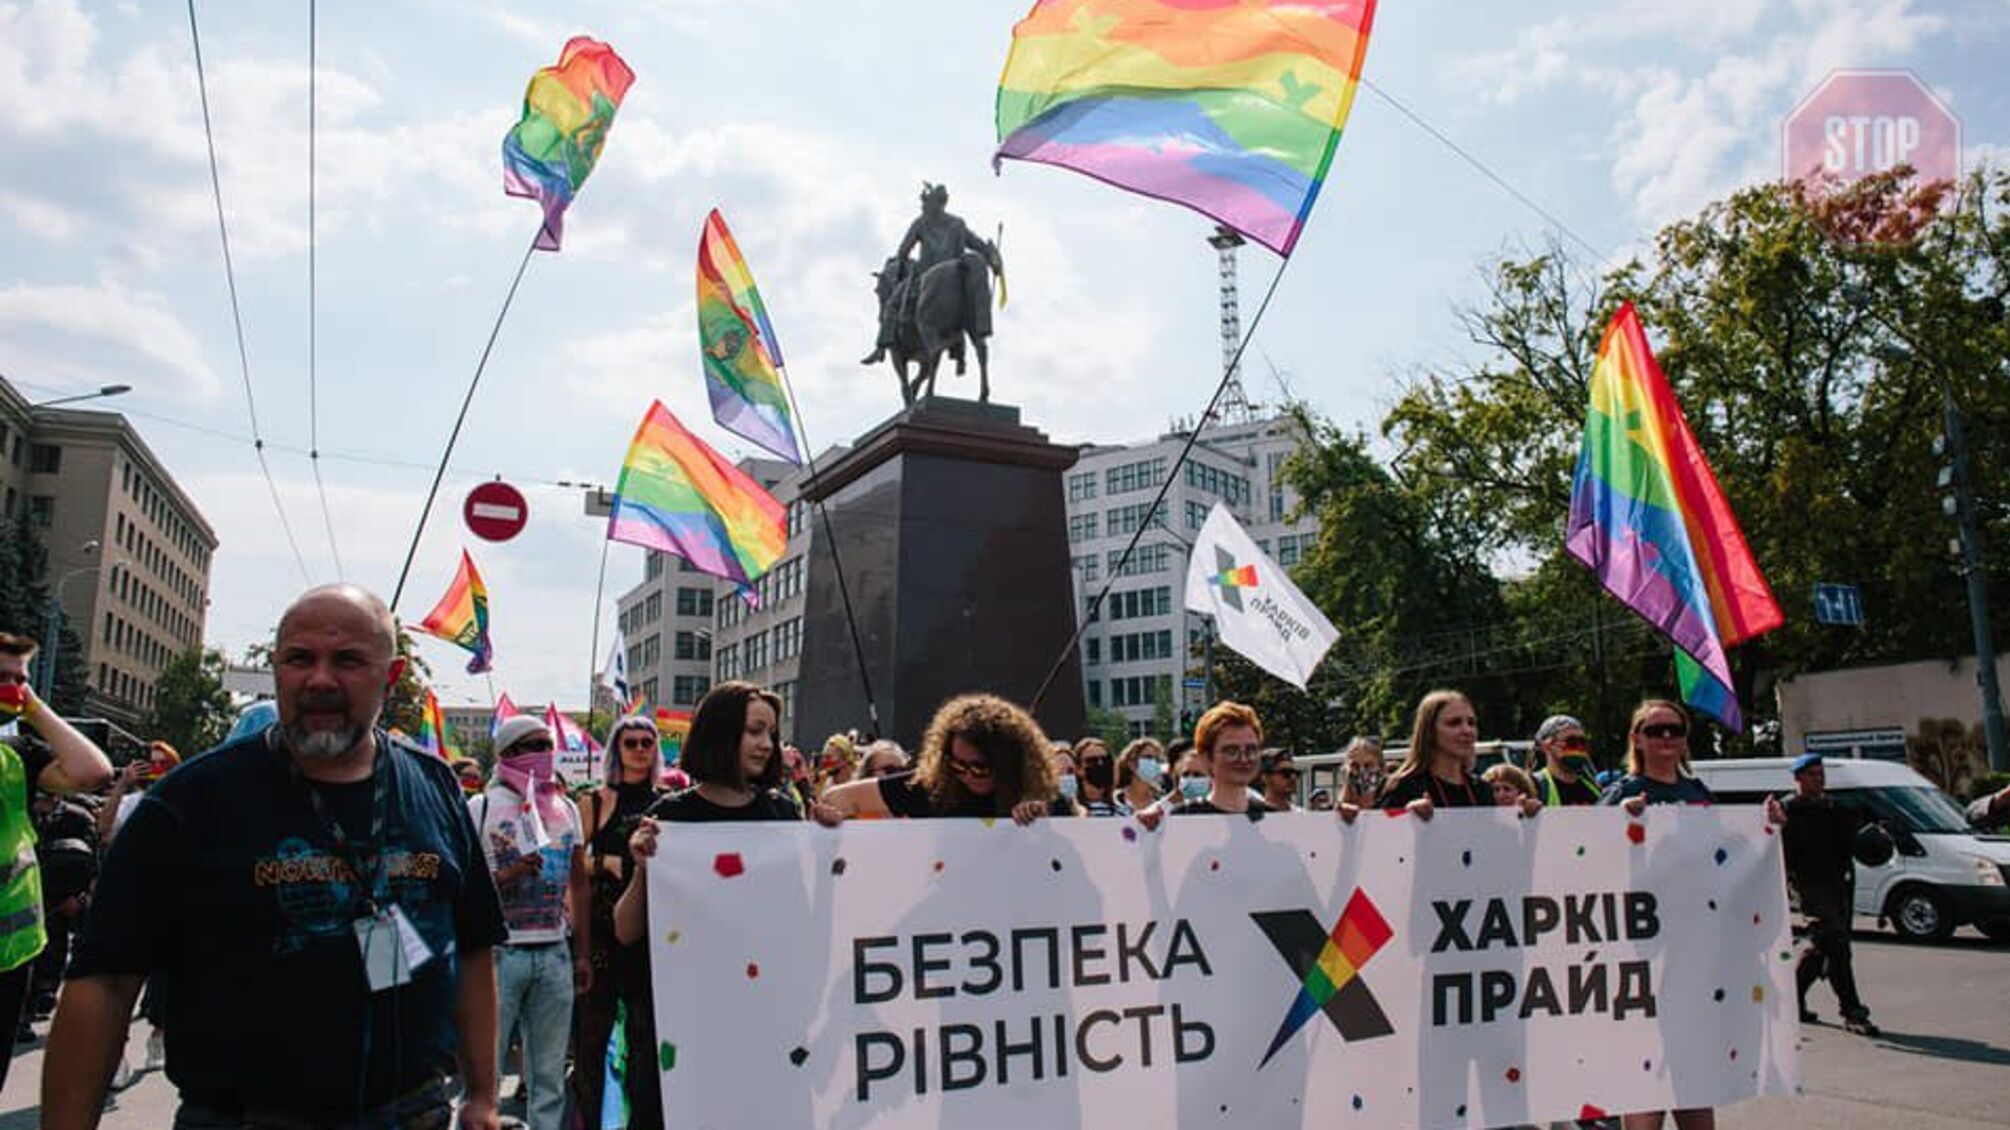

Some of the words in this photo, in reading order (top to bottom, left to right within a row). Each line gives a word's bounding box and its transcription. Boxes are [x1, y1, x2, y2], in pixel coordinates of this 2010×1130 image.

[853, 918, 1213, 1004] БЕЗПЕКА
[1431, 891, 1661, 953] ХАРКІВ
[1432, 951, 1657, 1026] ПРАЙД
[854, 1002, 1215, 1101] РІВНІСТЬ
